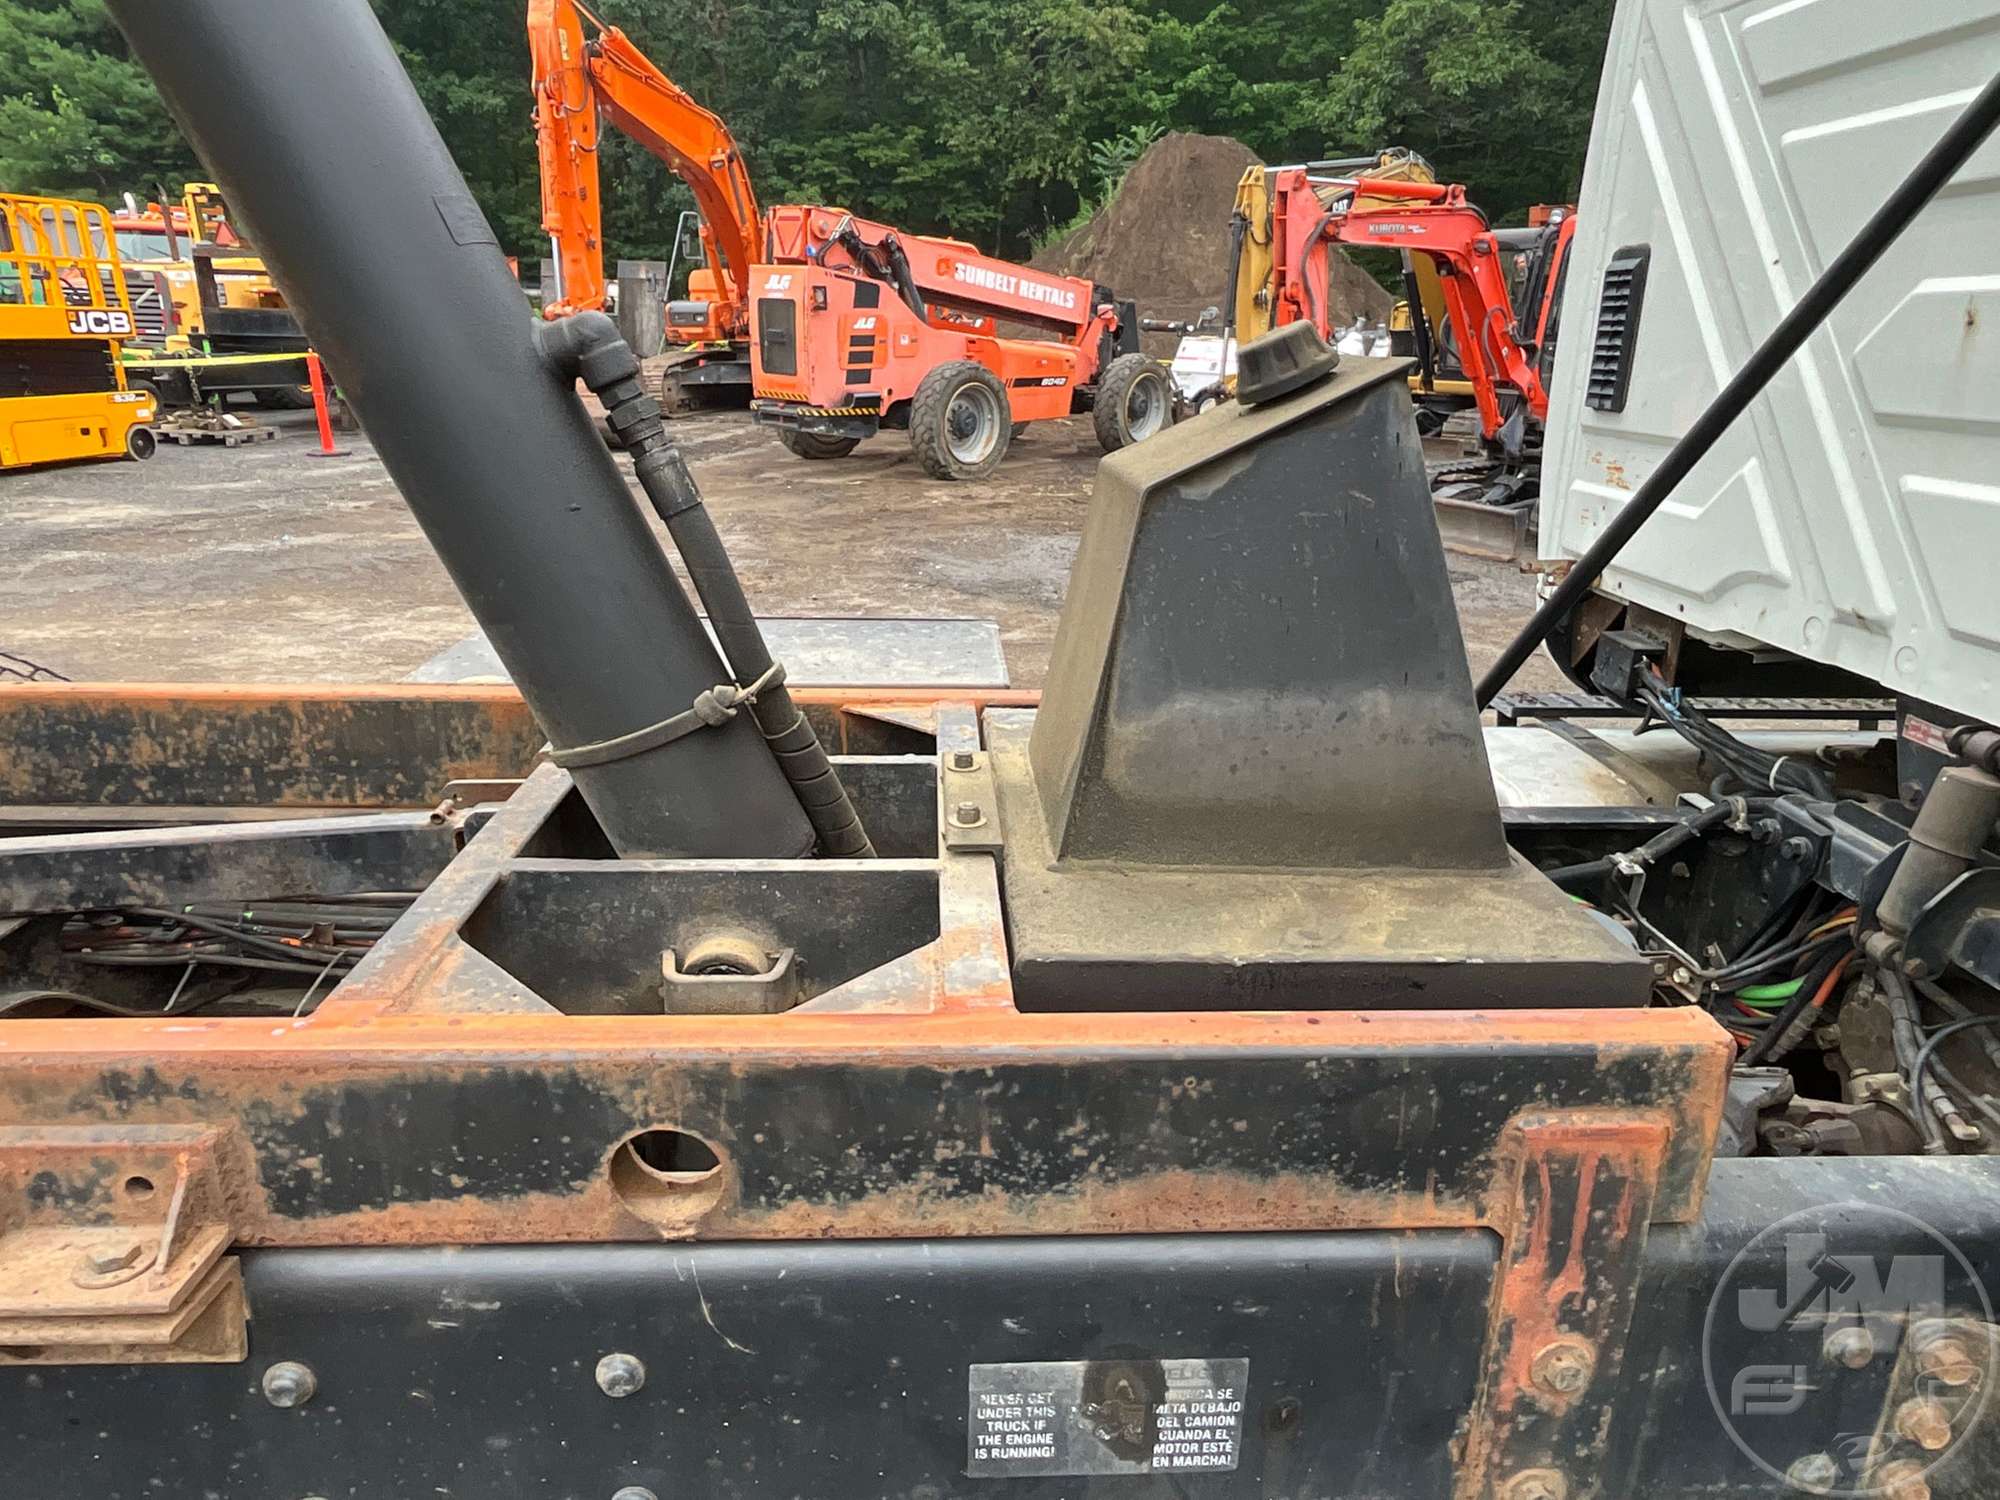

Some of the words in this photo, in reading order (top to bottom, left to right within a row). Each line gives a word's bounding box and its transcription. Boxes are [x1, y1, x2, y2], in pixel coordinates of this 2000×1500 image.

[1332, 200, 1349, 213] CAT
[1368, 222, 1406, 234] KUBOTA
[764, 274, 793, 290] JLG
[954, 262, 1018, 295] SUNBELT
[1018, 279, 1076, 309] RENTALS
[69, 310, 132, 334] JCB
[853, 316, 877, 330] JLG
[1028, 1391, 1055, 1404] GET
[1217, 1388, 1233, 1400] SE
[976, 1406, 1022, 1419] UNDER
[1025, 1405, 1056, 1418] THIS
[986, 1421, 1031, 1432] TRUCK
[1034, 1420, 1046, 1431] IF
[1156, 1417, 1181, 1428] DEL
[1184, 1415, 1235, 1427] CAMION
[977, 1434, 1002, 1446] THE
[1005, 1433, 1054, 1445] ENGINE
[1158, 1429, 1212, 1441] CUANDA
[1215, 1429, 1230, 1440] EL
[974, 1448, 988, 1459] IS
[991, 1446, 1055, 1459] RUNNING!
[1153, 1443, 1199, 1454] MOTOR
[1152, 1456, 1169, 1468] EN
[1172, 1455, 1231, 1467] MARCHA!
